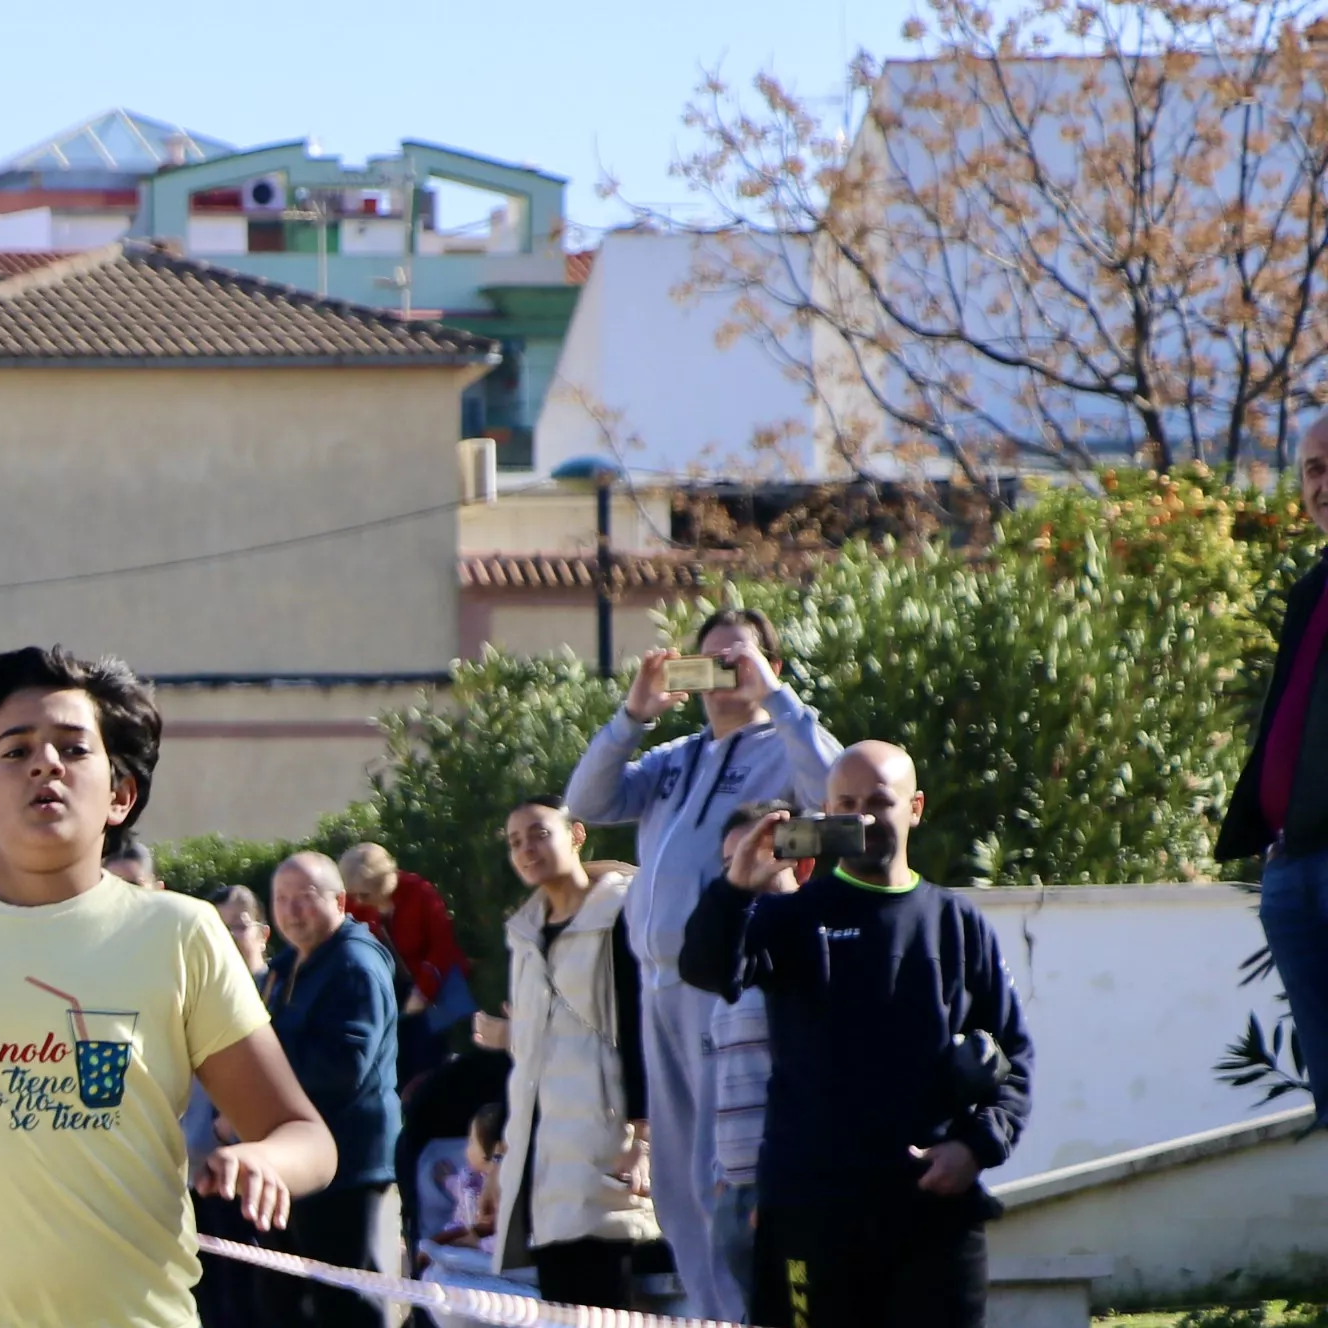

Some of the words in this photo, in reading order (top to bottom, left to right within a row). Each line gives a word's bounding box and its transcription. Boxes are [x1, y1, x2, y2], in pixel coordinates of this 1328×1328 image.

[1, 1066, 77, 1095] tiene
[15, 1089, 54, 1112] no
[9, 1109, 39, 1131] se
[46, 1102, 113, 1131] tiene
